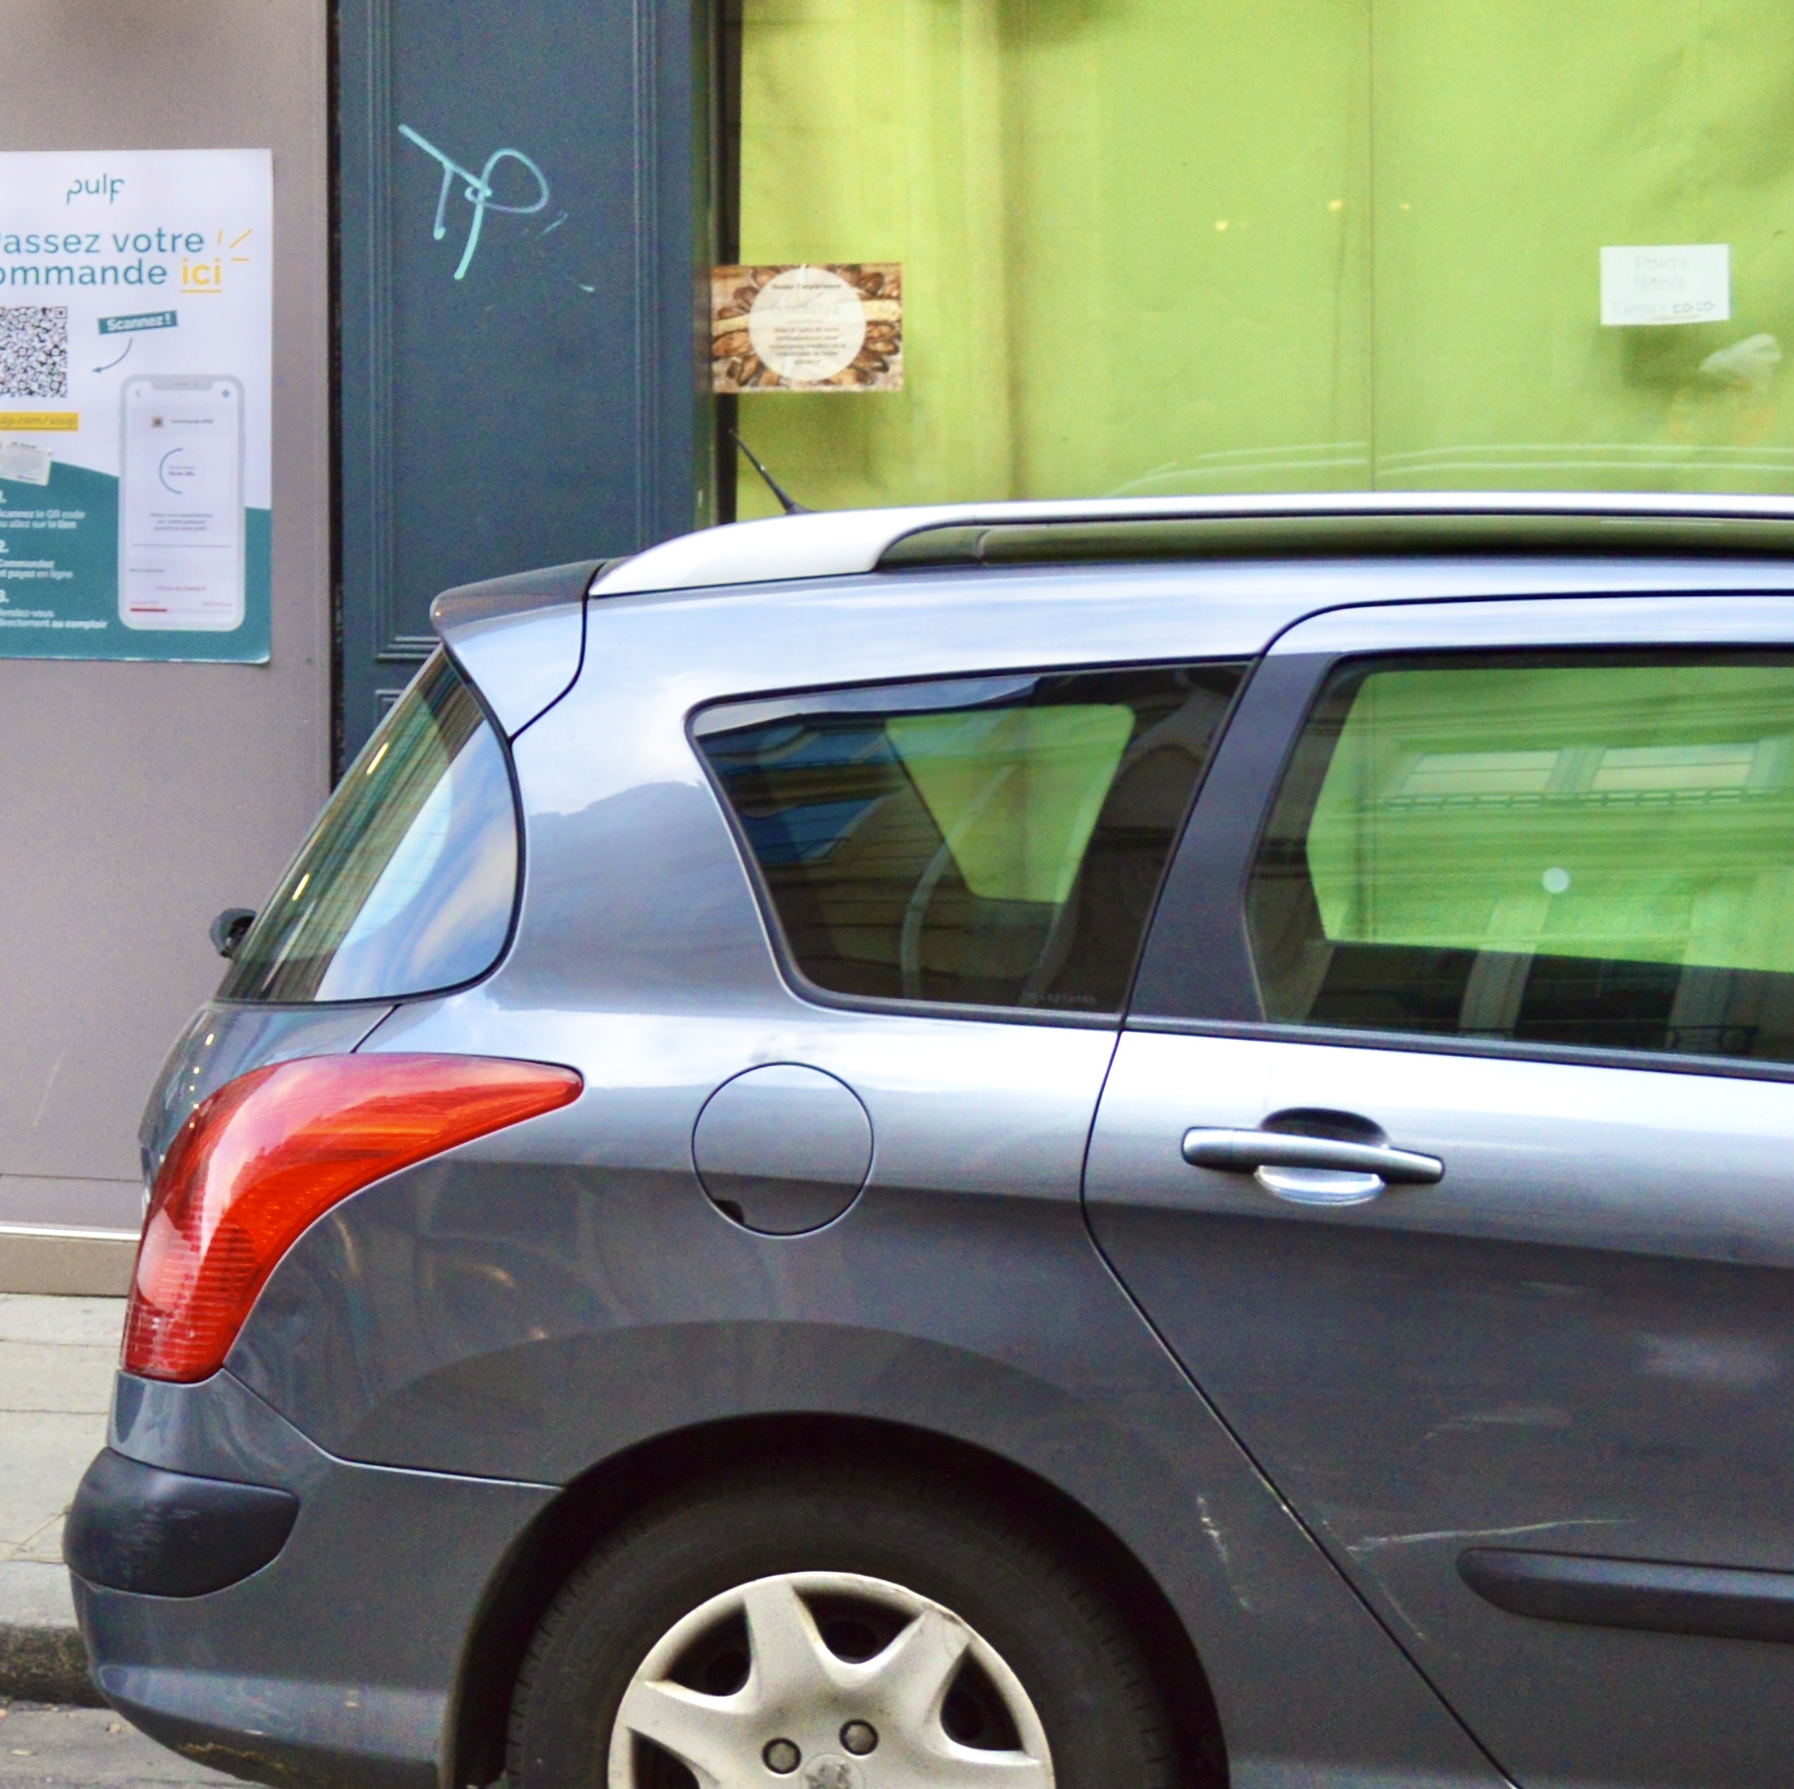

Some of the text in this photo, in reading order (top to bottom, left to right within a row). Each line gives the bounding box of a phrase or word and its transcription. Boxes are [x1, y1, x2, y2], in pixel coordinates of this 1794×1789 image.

[65, 173, 126, 206] pulp
[112, 227, 205, 254] votre
[180, 257, 223, 286] ici
